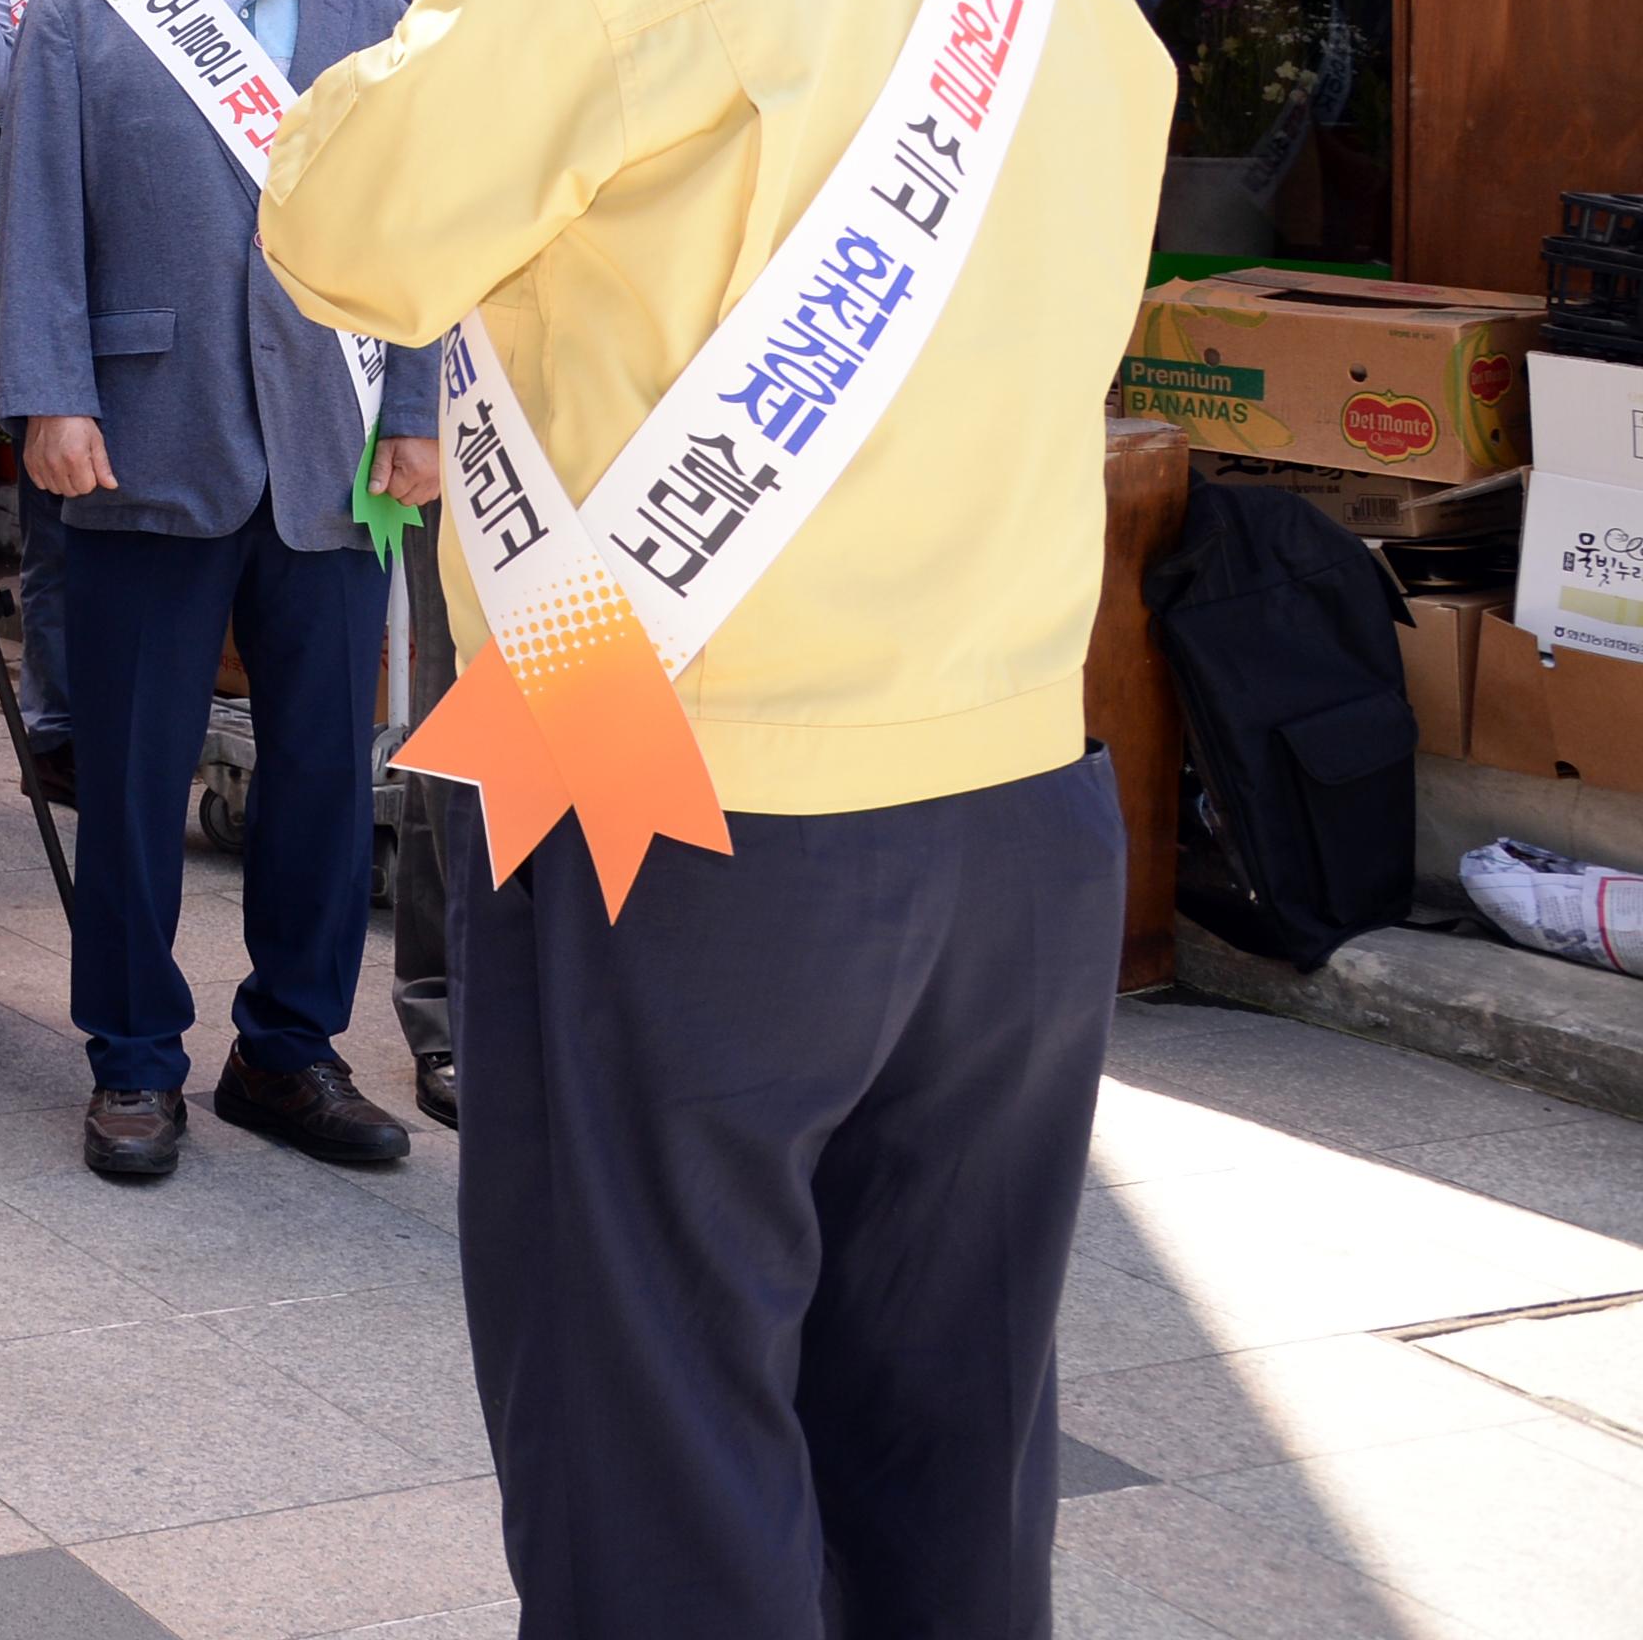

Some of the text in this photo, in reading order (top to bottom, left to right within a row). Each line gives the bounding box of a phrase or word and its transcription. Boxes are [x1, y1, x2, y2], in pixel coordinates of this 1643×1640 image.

[868, 113, 969, 242] 쓰고
[718, 223, 917, 458] 화천경제
[1130, 361, 1232, 392] Premium
[1131, 391, 1248, 424] BANANAS
[1348, 409, 1431, 437] Del Monte
[450, 400, 550, 575] 살리고
[607, 429, 785, 600] 살리고
